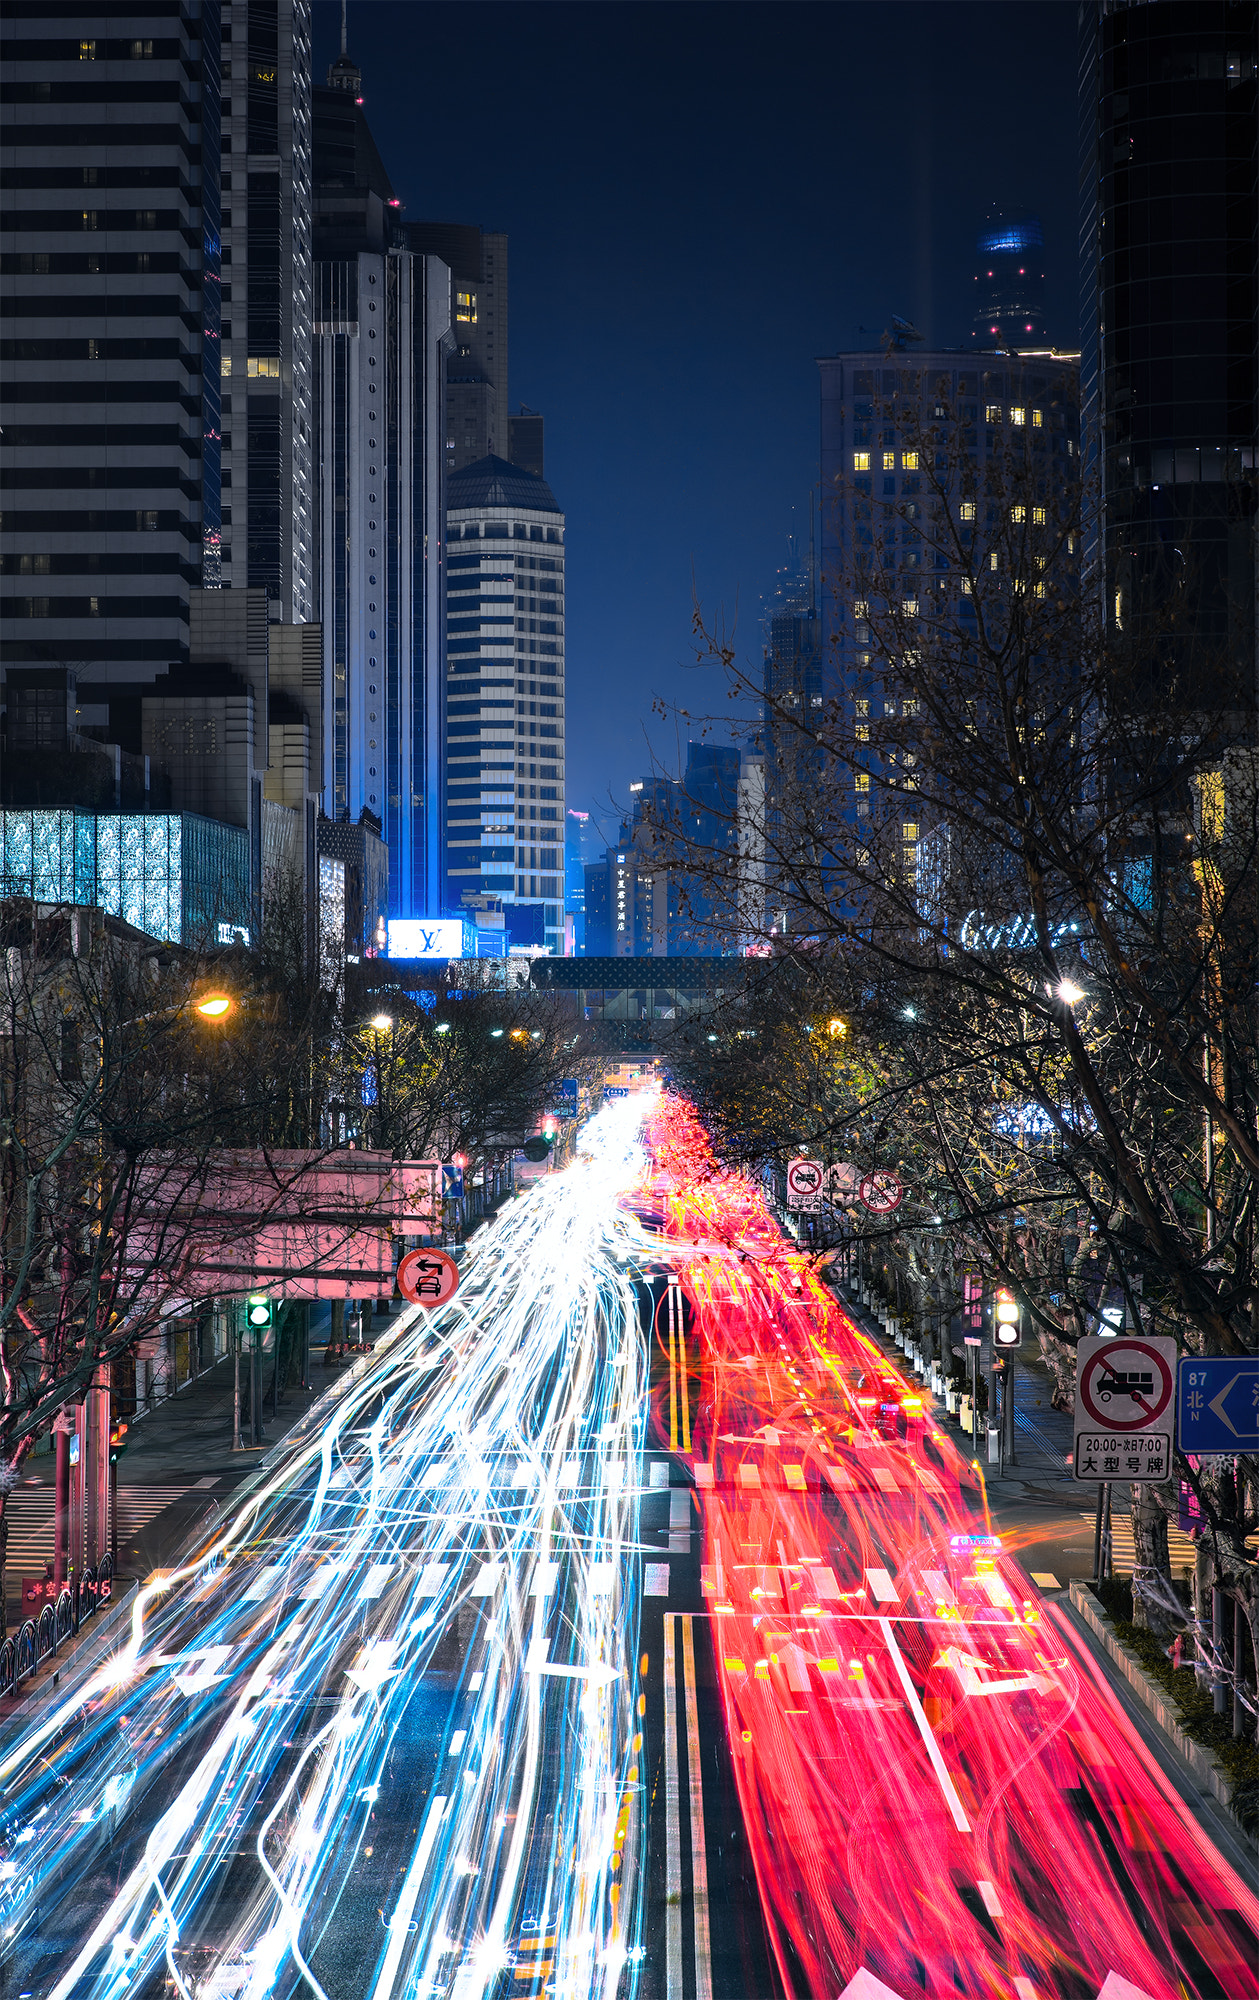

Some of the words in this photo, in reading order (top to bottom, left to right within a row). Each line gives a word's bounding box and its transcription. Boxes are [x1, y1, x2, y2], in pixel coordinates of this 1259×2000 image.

[152, 717, 220, 754] K11
[1189, 1372, 1207, 1386] 87
[1187, 1391, 1204, 1408] 北
[1191, 1411, 1200, 1421] N
[1081, 1456, 1164, 1474] 大型号牌
[79, 1581, 112, 1597] 146
